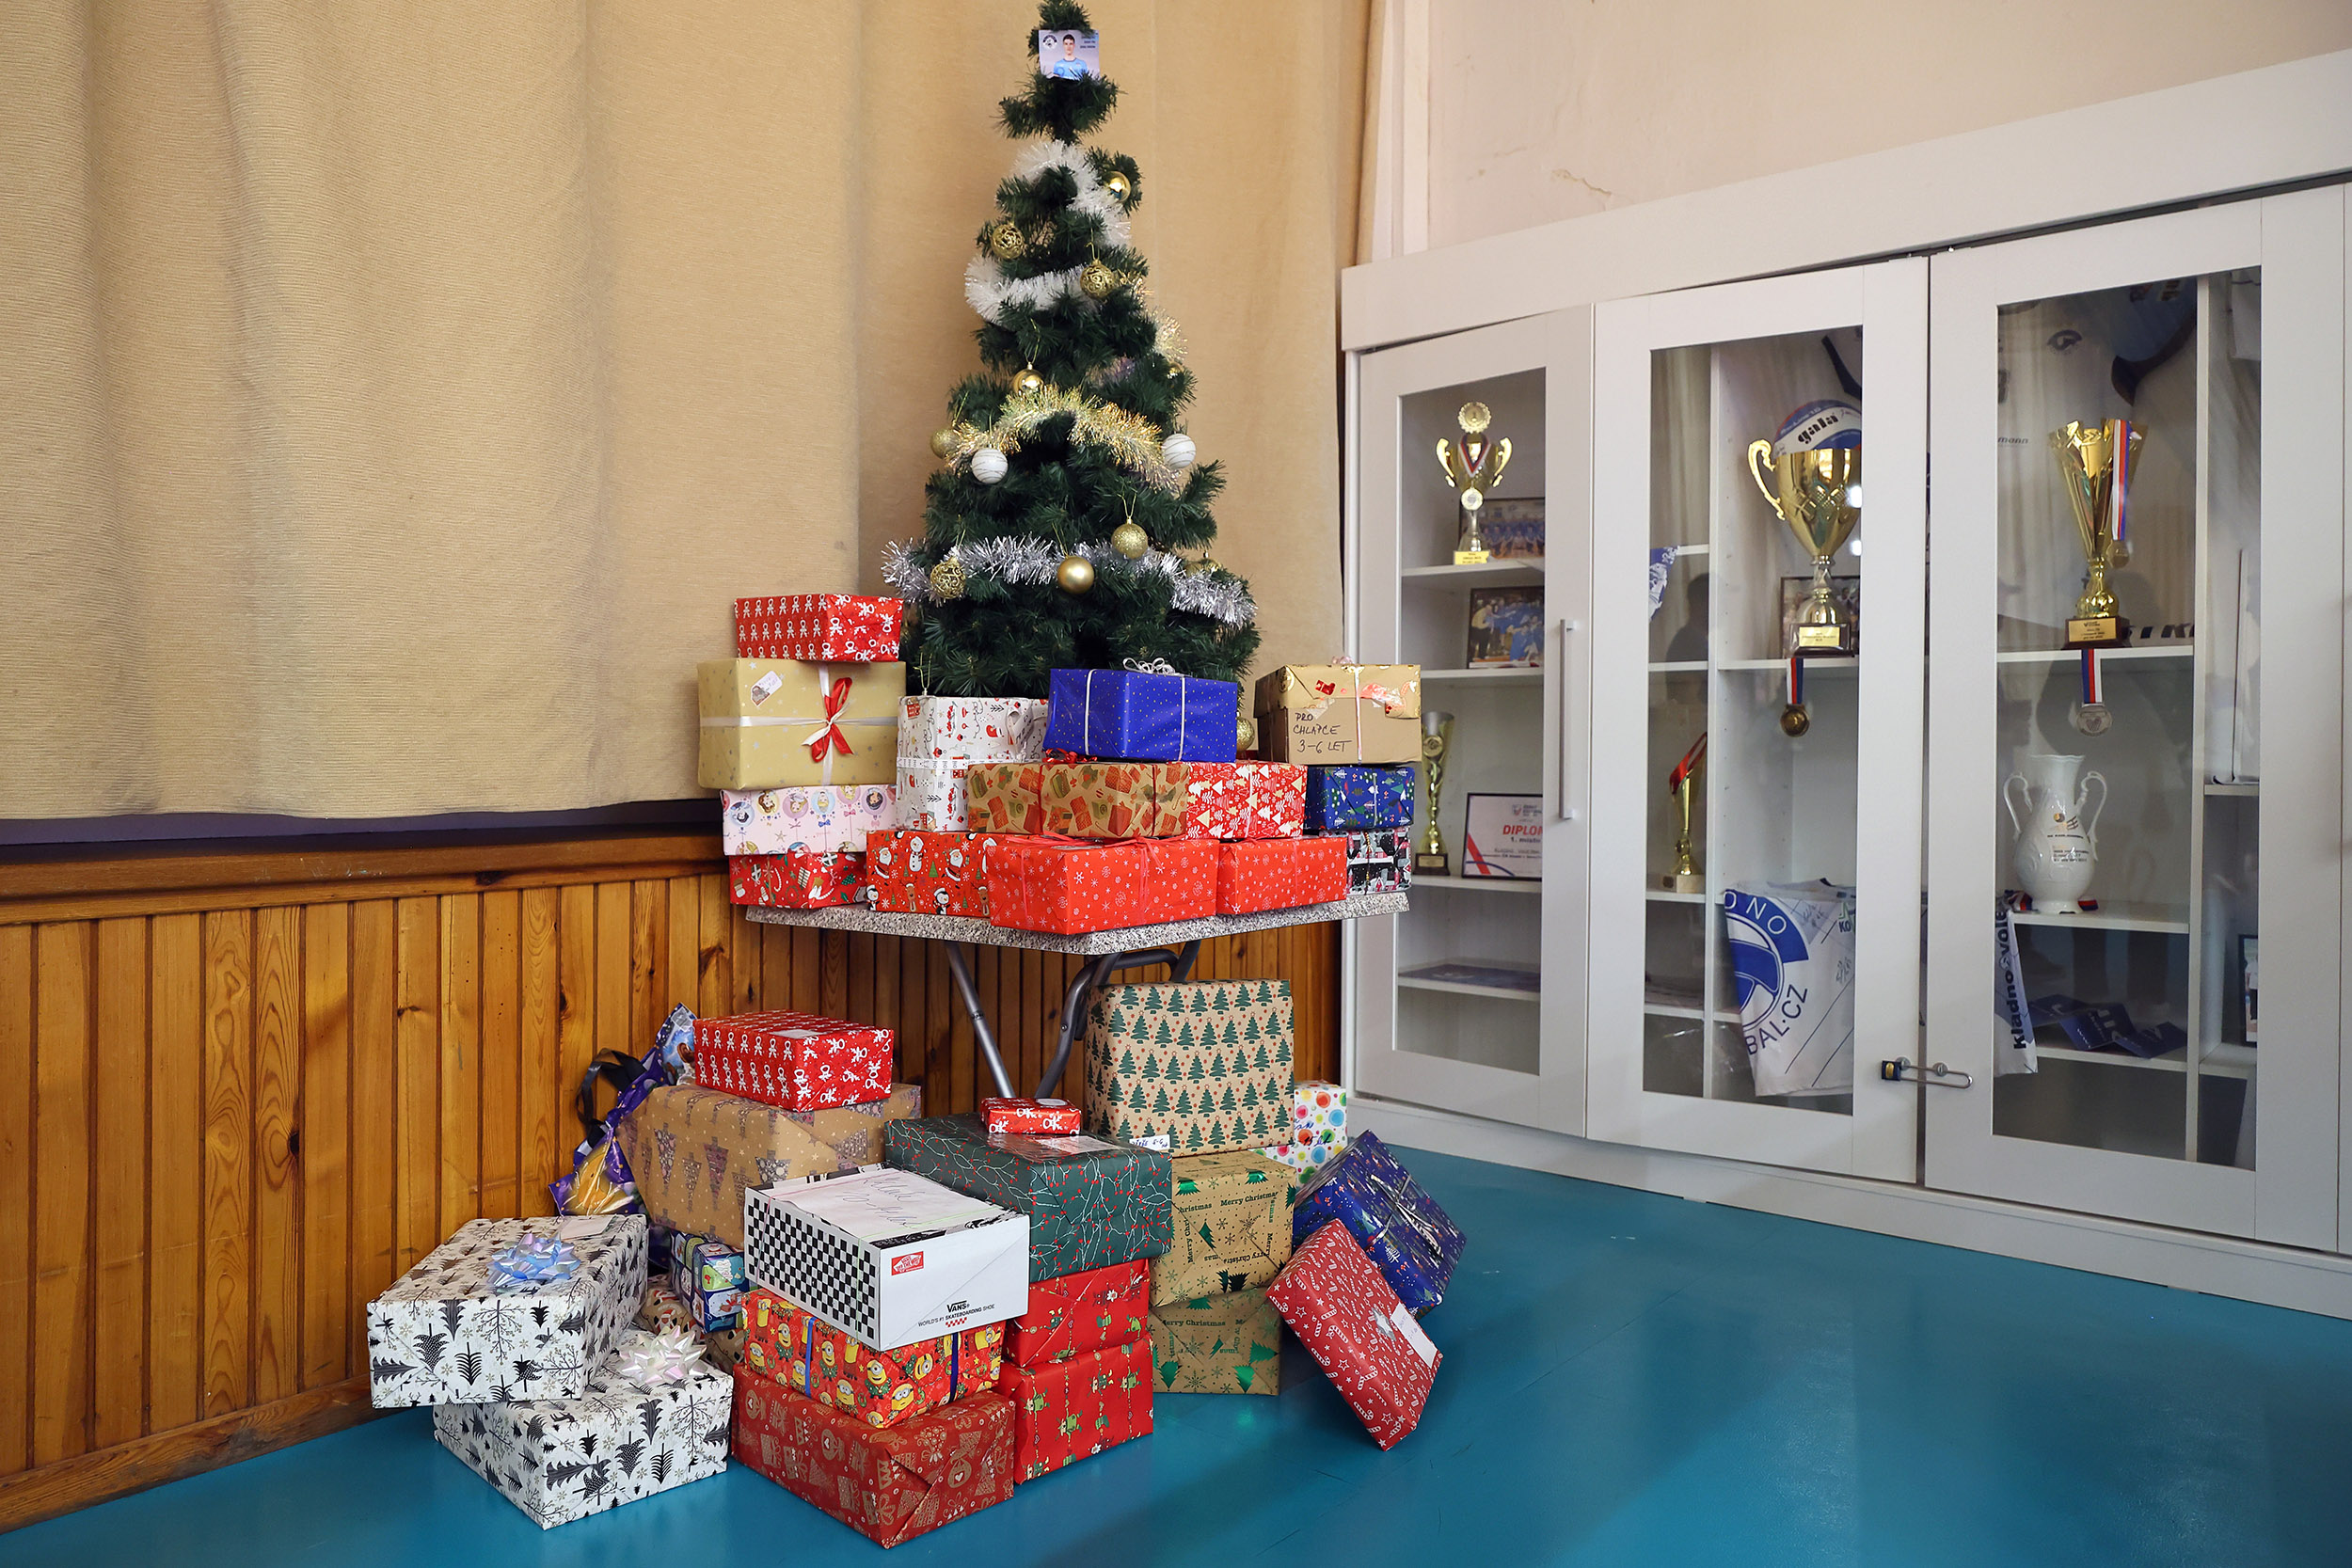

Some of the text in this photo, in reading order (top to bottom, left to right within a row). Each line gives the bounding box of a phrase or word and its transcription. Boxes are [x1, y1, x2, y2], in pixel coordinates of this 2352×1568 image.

[1798, 414, 1839, 445] gala
[1295, 712, 1314, 721] PRO
[1293, 723, 1341, 736] CHLAPCE
[1296, 738, 1353, 754] 3-6 LET
[1220, 1197, 1244, 1207] Merry
[917, 1317, 939, 1327] WORLD'S
[945, 1307, 982, 1321] SKATEBOARDING
[982, 1304, 995, 1312] SHOE
[1185, 1319, 1226, 1327] Christmas
